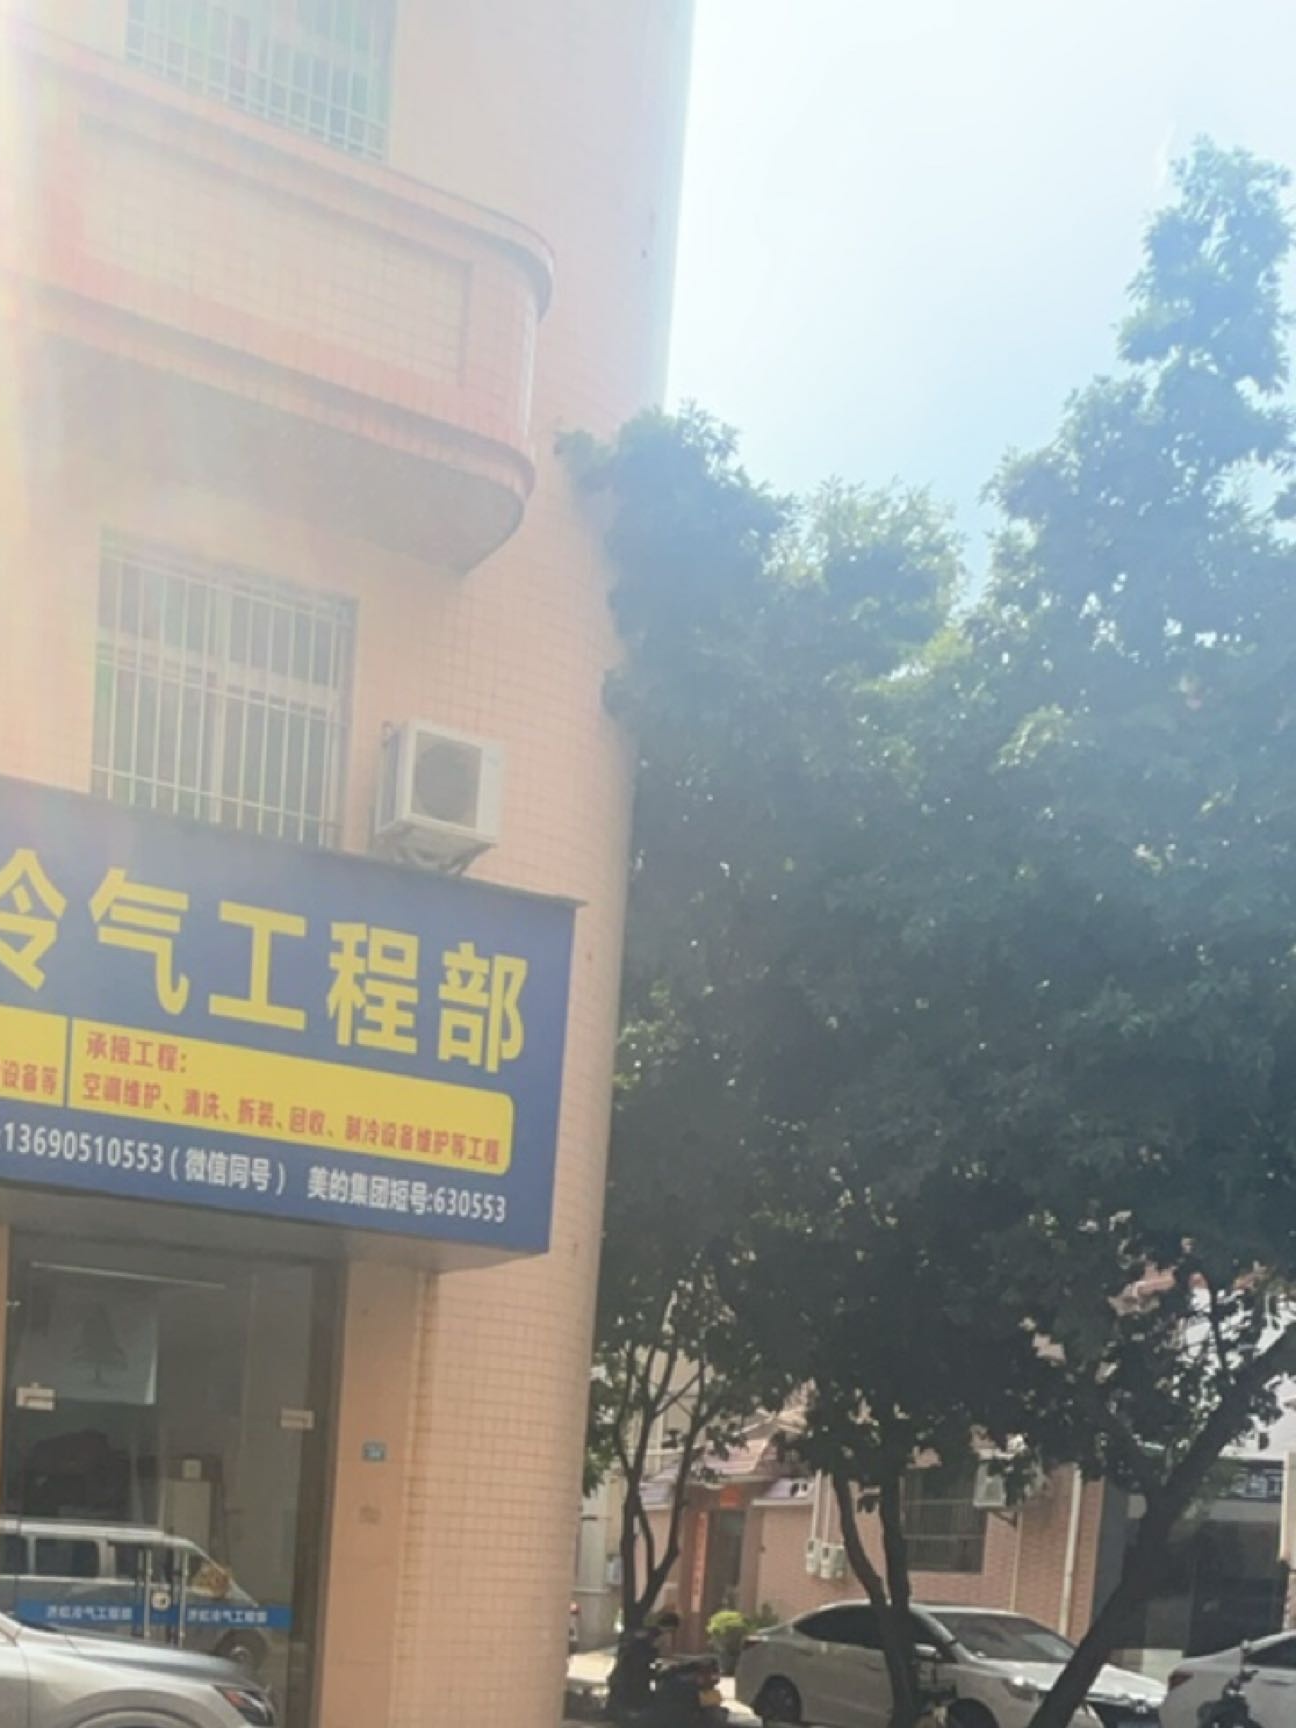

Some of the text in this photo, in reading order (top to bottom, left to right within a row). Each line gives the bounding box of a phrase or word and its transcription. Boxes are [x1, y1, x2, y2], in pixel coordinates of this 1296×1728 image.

[85, 1030, 188, 1074] 承接工程:
[307, 1165, 508, 1224] 美的集团短号:630553
